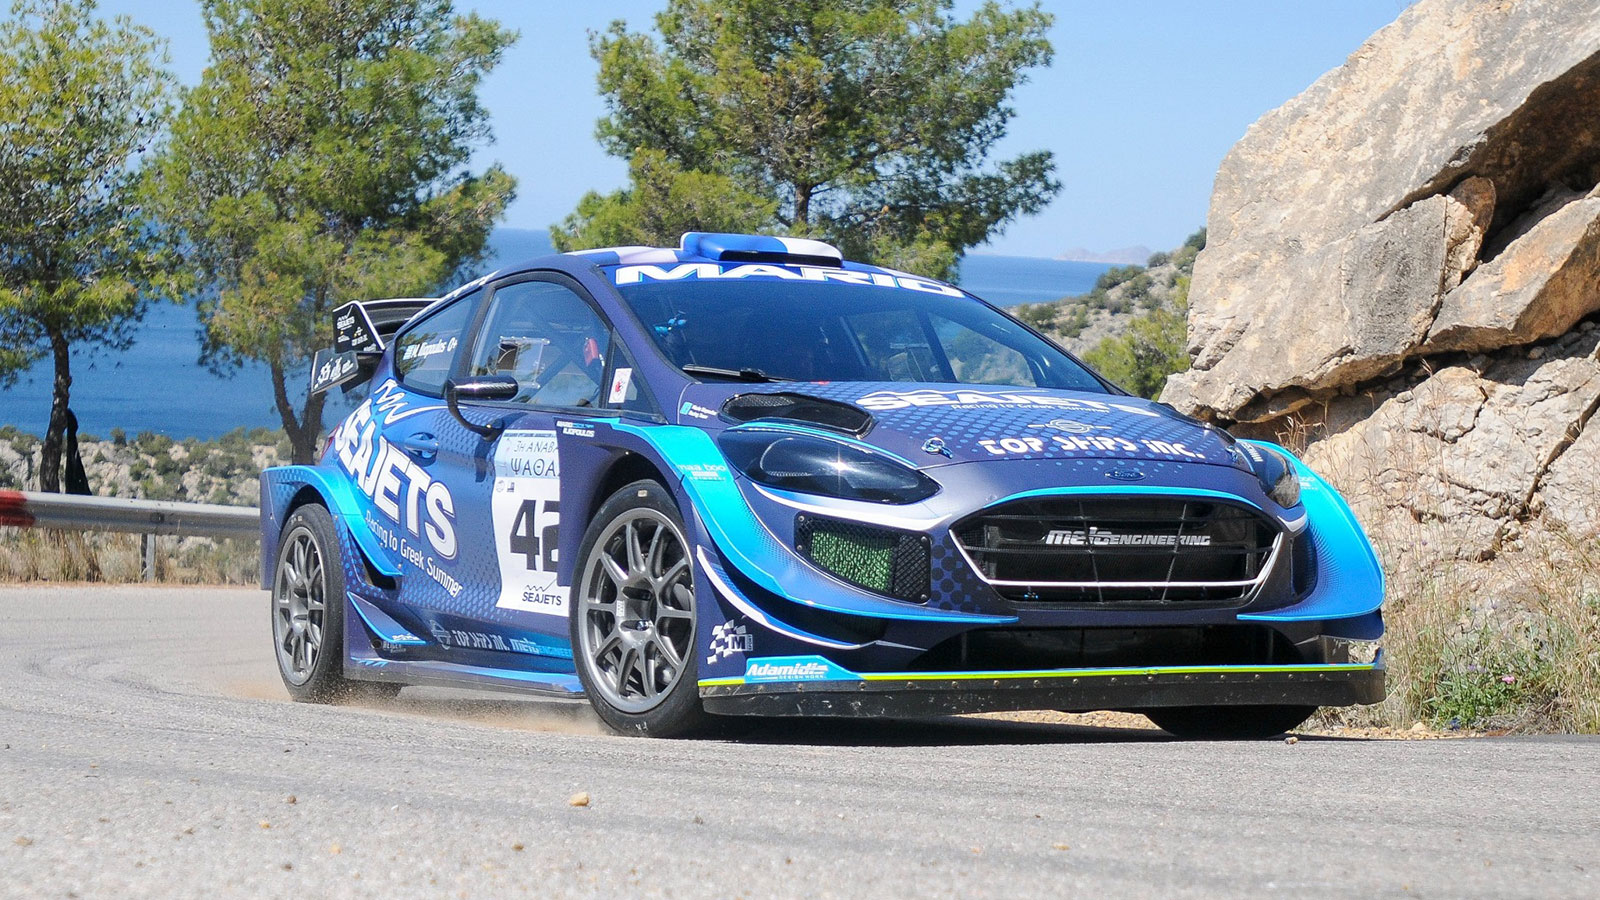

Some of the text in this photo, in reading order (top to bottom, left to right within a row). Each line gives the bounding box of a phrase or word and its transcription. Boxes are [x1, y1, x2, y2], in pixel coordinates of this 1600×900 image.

[615, 263, 966, 299] MARIO
[855, 392, 1160, 418] SEAJETS
[978, 437, 1045, 455] TOP
[1050, 436, 1139, 452] SHIPS
[335, 399, 457, 560] SEAJETS
[511, 457, 560, 477] ΨΑΘΑ
[509, 499, 560, 573] 42
[366, 510, 463, 598] Racing to Greek Summer
[522, 591, 562, 606] SEAJETS
